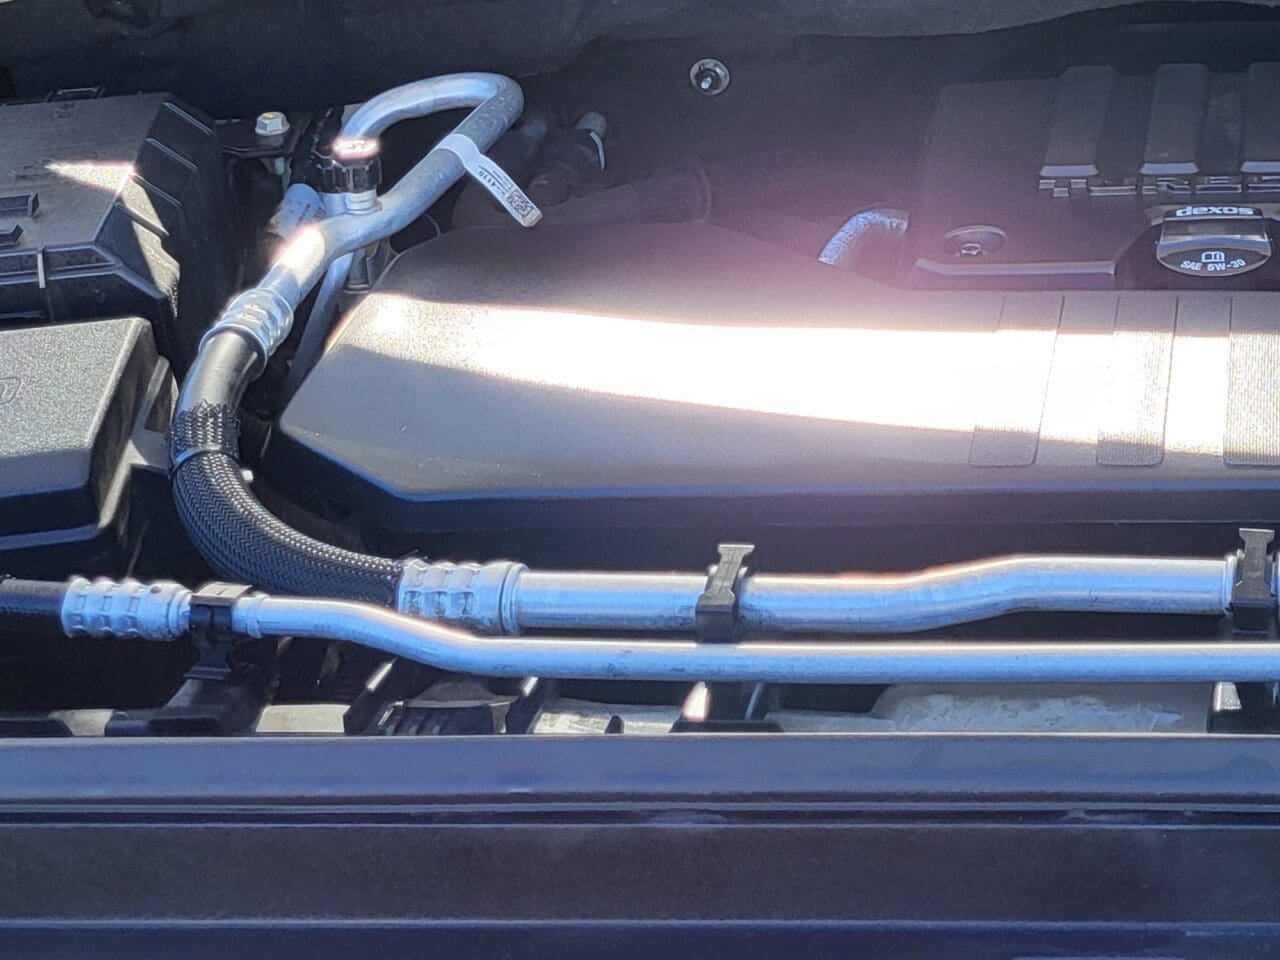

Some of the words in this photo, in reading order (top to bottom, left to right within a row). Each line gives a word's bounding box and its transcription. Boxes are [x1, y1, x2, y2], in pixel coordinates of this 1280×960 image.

[1176, 206, 1254, 217] dexos
[1180, 260, 1202, 271] SAE
[1207, 258, 1246, 271] 5W-30
